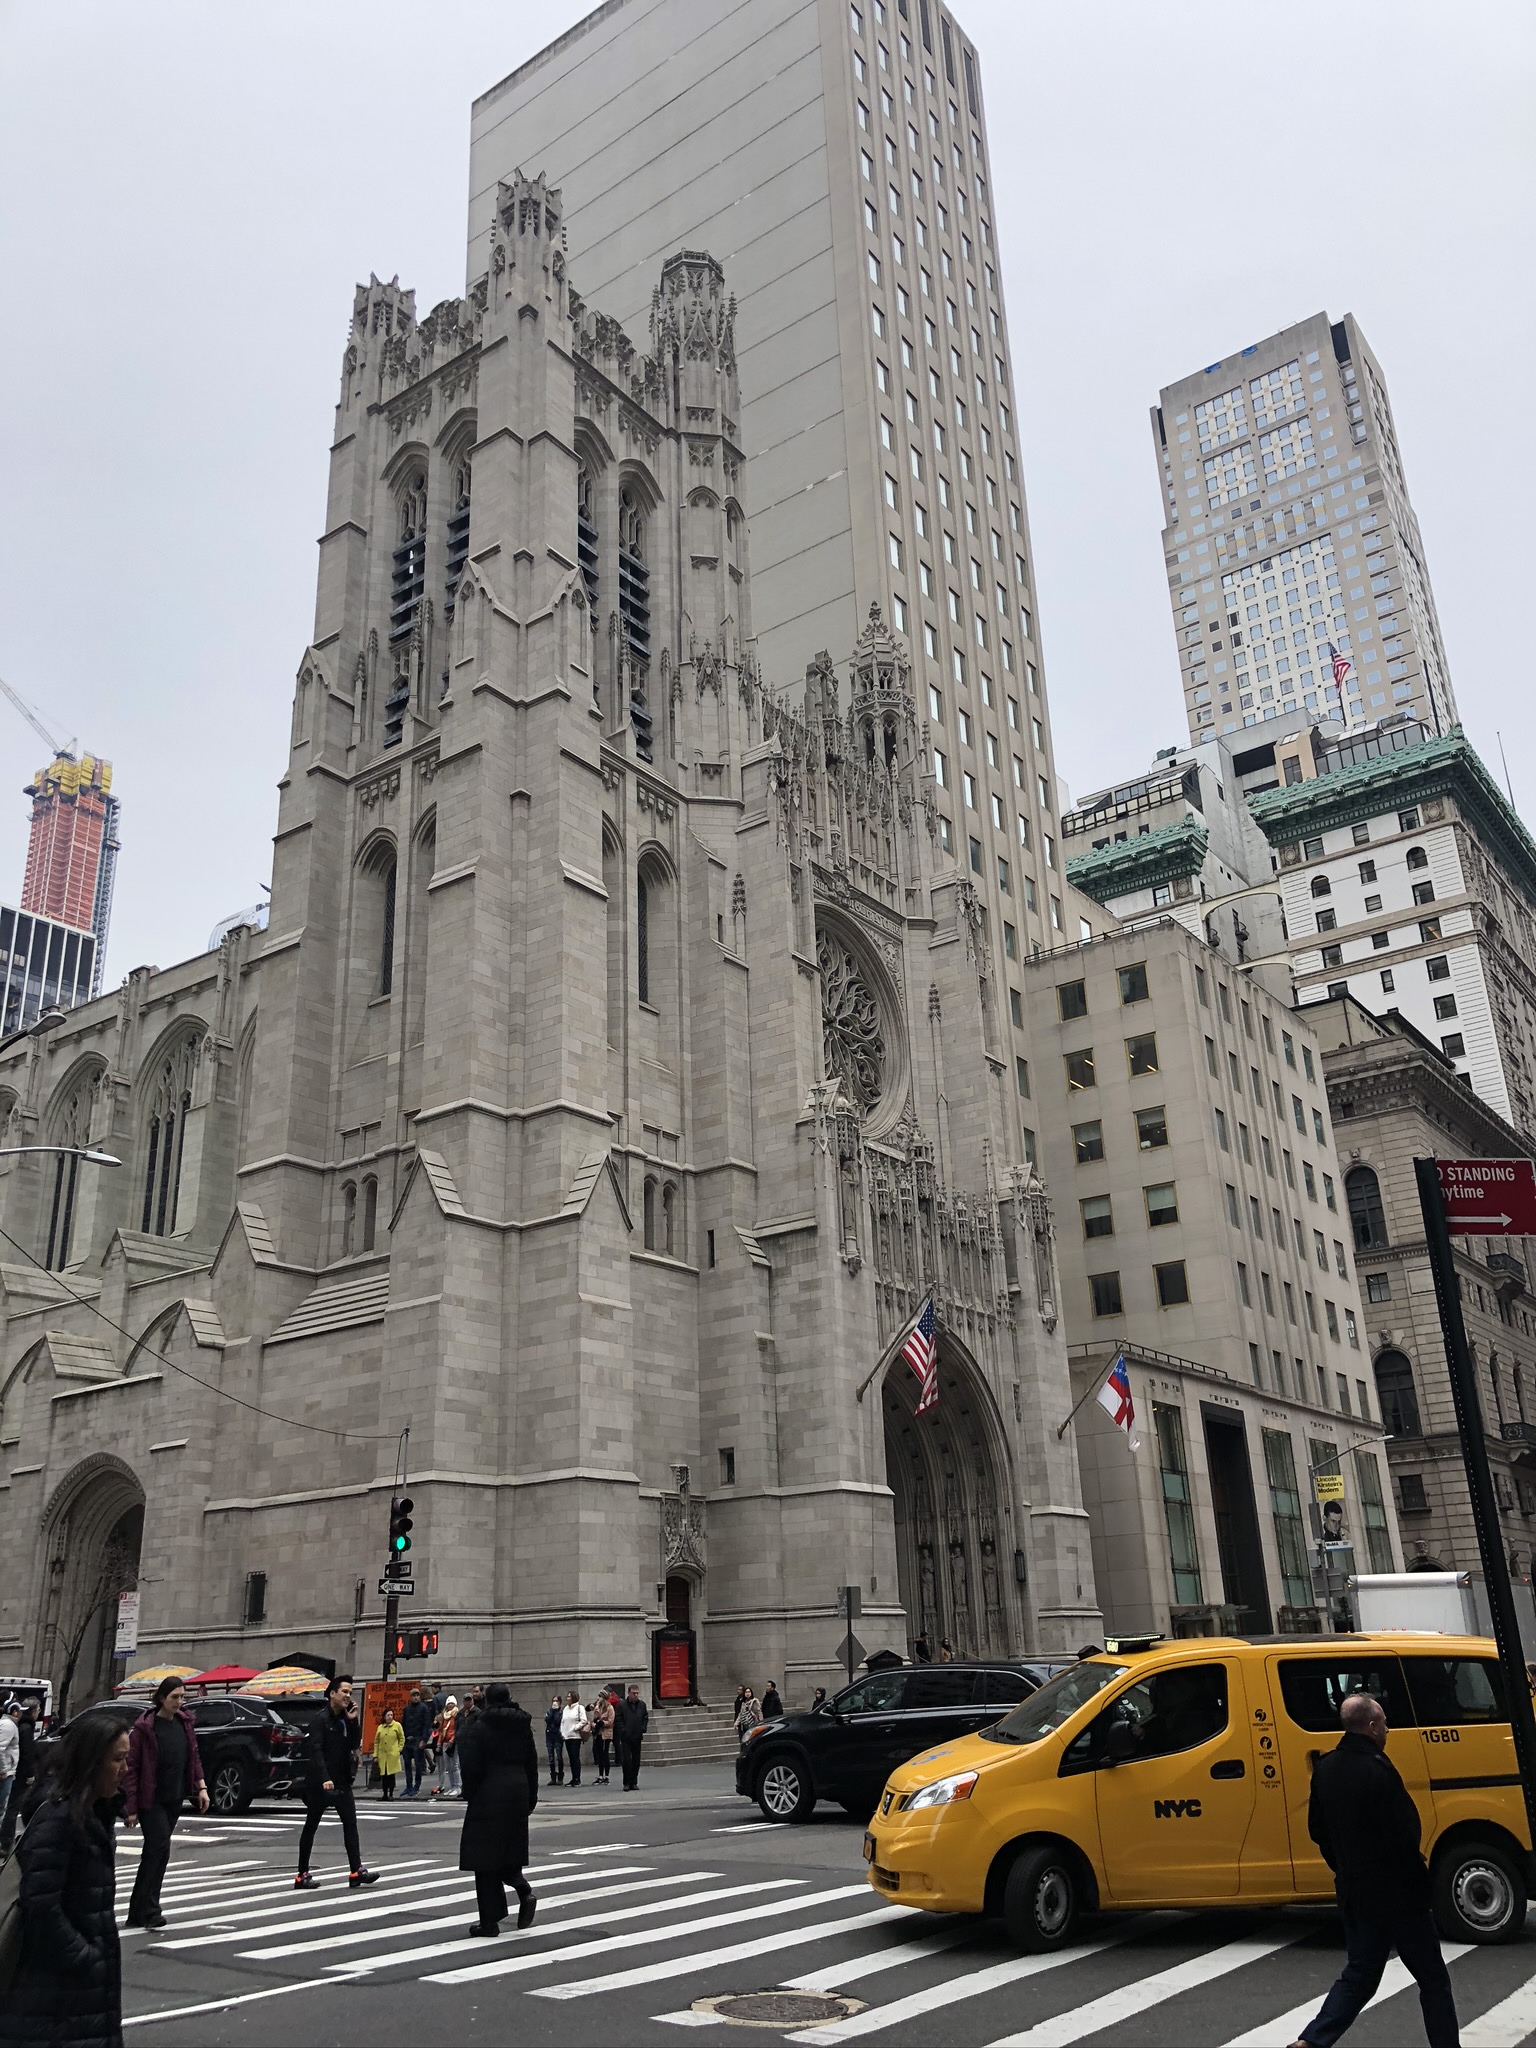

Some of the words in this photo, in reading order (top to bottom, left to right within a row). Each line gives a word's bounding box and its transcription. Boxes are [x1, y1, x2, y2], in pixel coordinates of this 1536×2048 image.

[1446, 1167, 1515, 1181] STANDING
[1440, 1184, 1485, 1201] nytime
[1421, 1729, 1460, 1743] 1G80
[1154, 1799, 1202, 1818] NYC
